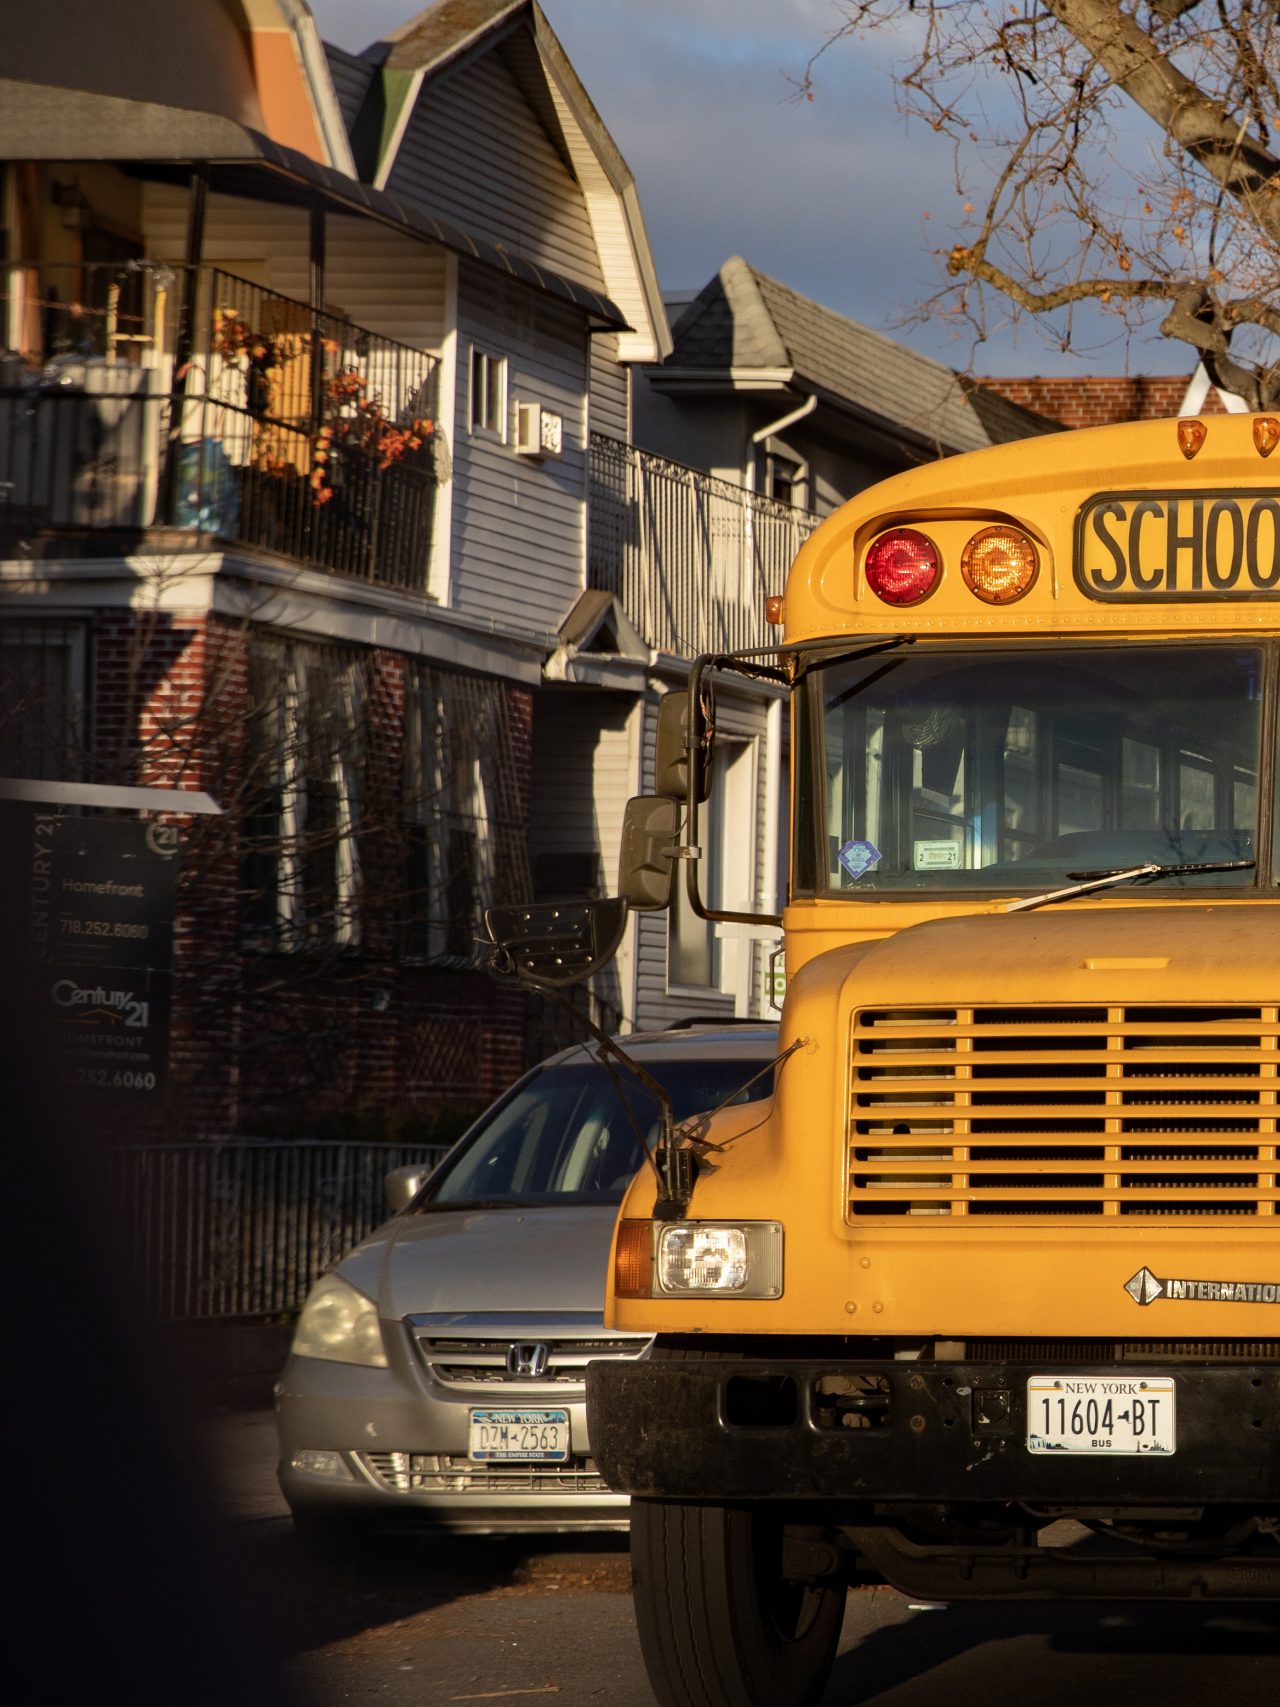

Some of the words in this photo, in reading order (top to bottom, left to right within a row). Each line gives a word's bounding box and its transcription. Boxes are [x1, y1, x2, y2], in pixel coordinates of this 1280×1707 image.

[62, 878, 145, 898] Homefront
[53, 979, 135, 1010] Century
[124, 1001, 150, 1028] 21
[1066, 1383, 1098, 1394] NEW
[1099, 1383, 1138, 1395] YORK
[495, 1413, 516, 1424] NEW
[519, 1413, 545, 1424] YORK
[1092, 1440, 1112, 1448] BUS
